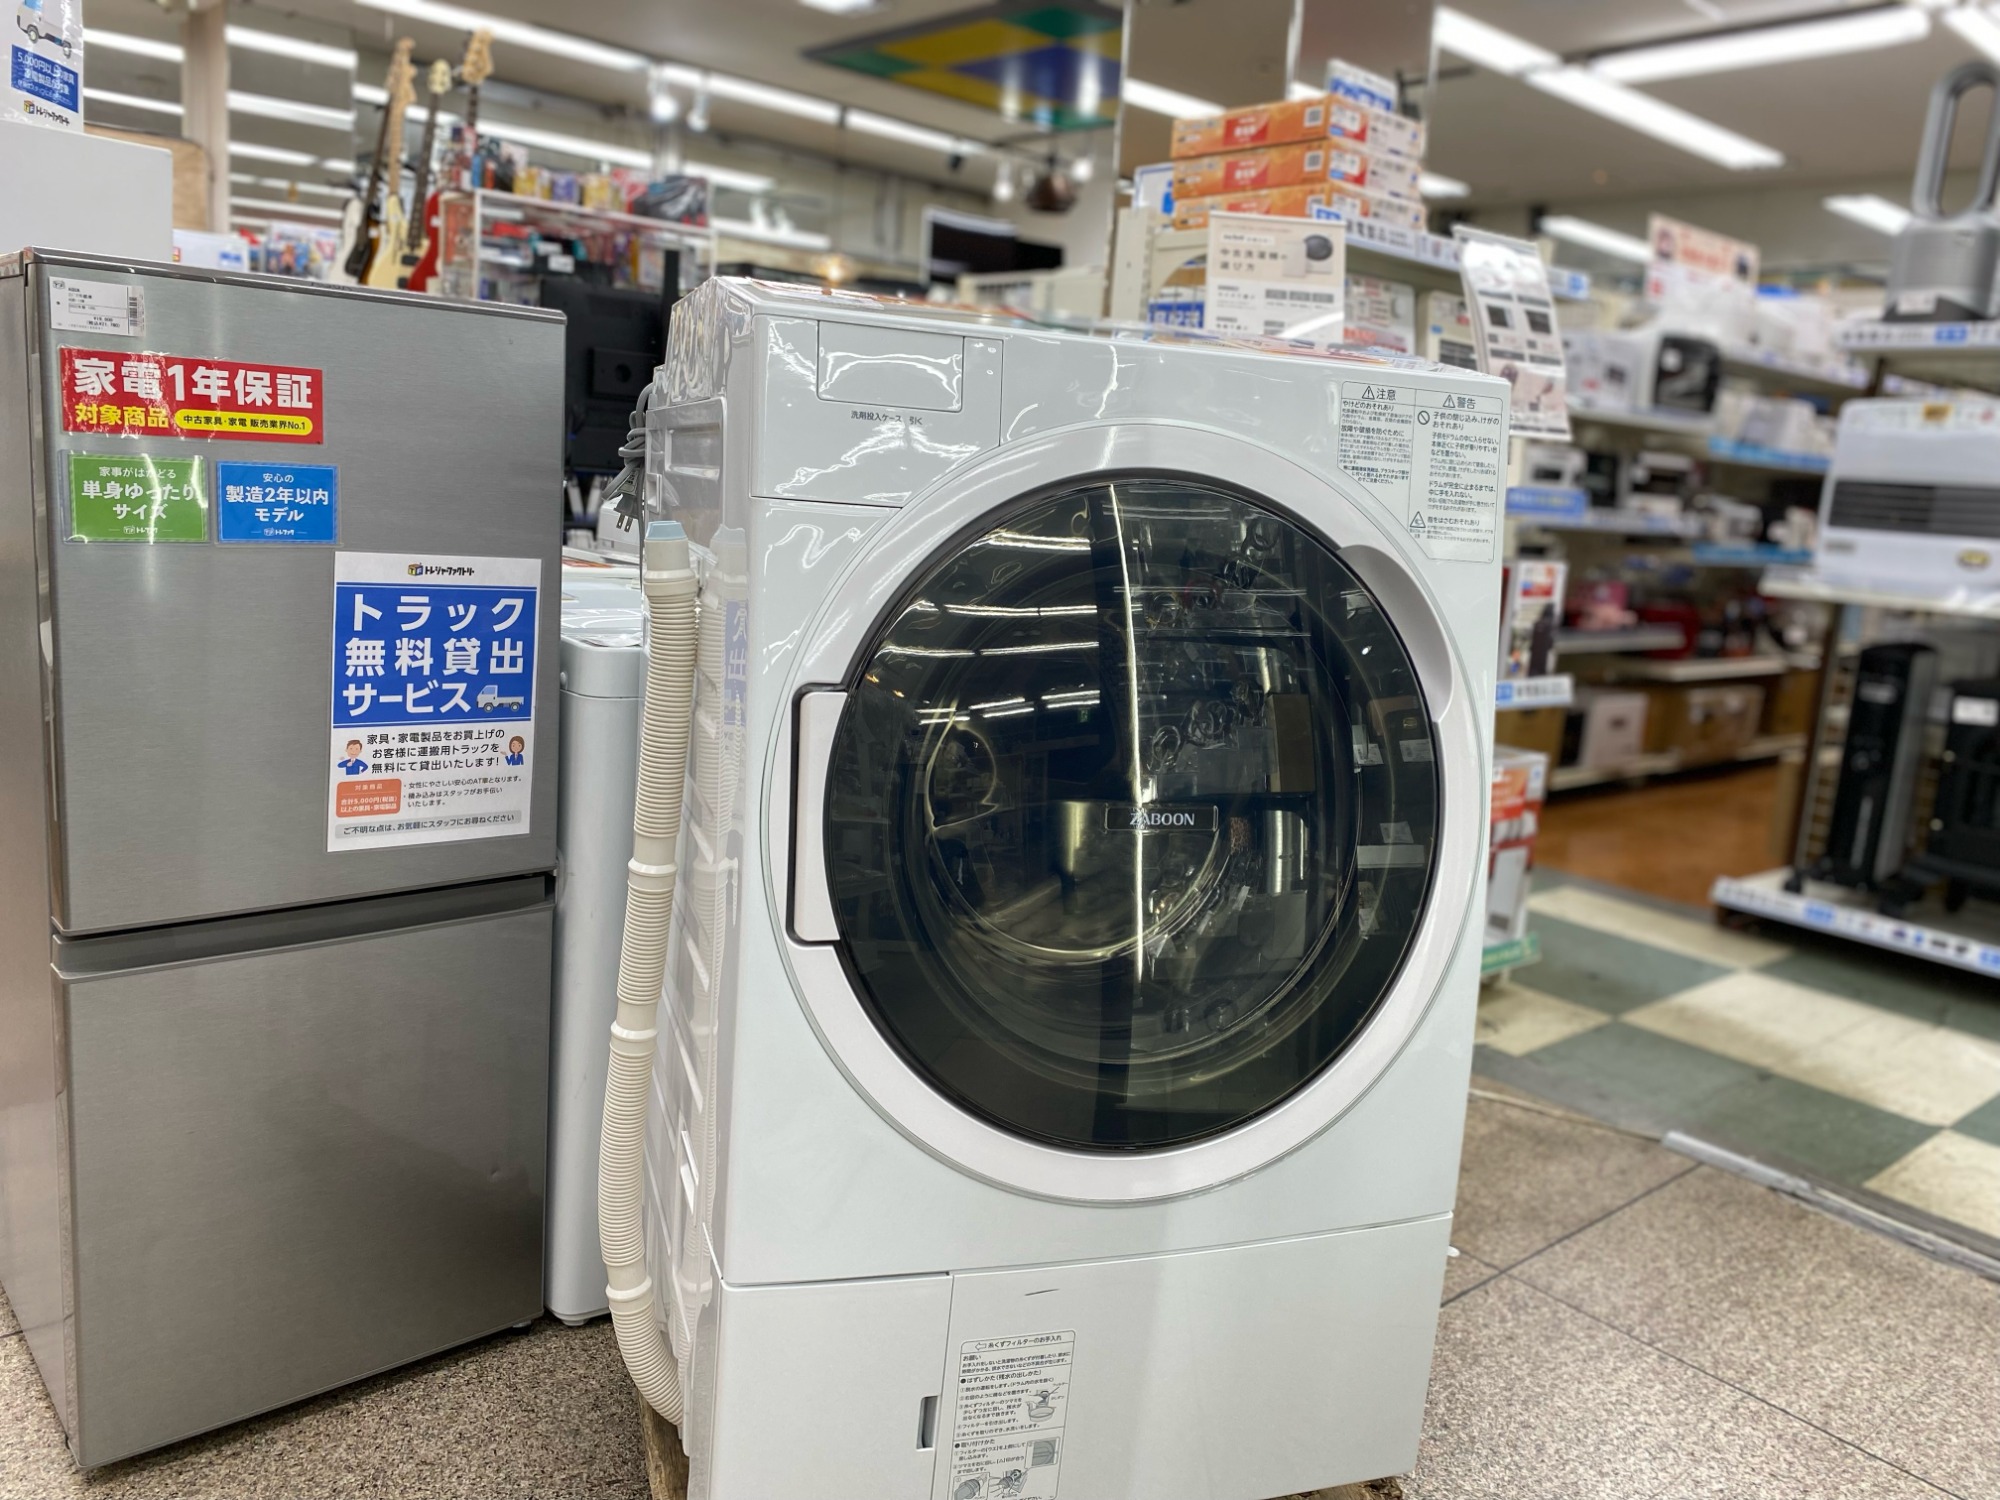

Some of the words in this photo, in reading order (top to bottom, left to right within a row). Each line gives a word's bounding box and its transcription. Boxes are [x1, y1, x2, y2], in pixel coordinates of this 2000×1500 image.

[73, 358, 313, 409] 家電1年保証
[1376, 388, 1397, 401] 注意
[1457, 396, 1476, 409] 警告
[1343, 400, 1394, 411] やけどのおそれあり
[75, 402, 170, 429] 対象商品
[1432, 421, 1464, 431] おそれあり
[263, 473, 295, 484] 安心の
[225, 485, 330, 506] 製造2年以内
[113, 503, 168, 520] サイズ
[254, 507, 305, 523] モデル
[352, 593, 525, 633] トラック
[345, 637, 525, 677] 無料貸出
[343, 679, 472, 717] サービス
[367, 729, 505, 745] 家具・家電製品をお買上げの
[372, 743, 499, 759] お客様に運搬用トラックを
[1129, 812, 1195, 826] ZABOON
[988, 1335, 1062, 1349] 糸くずフィルターのお手入れ
